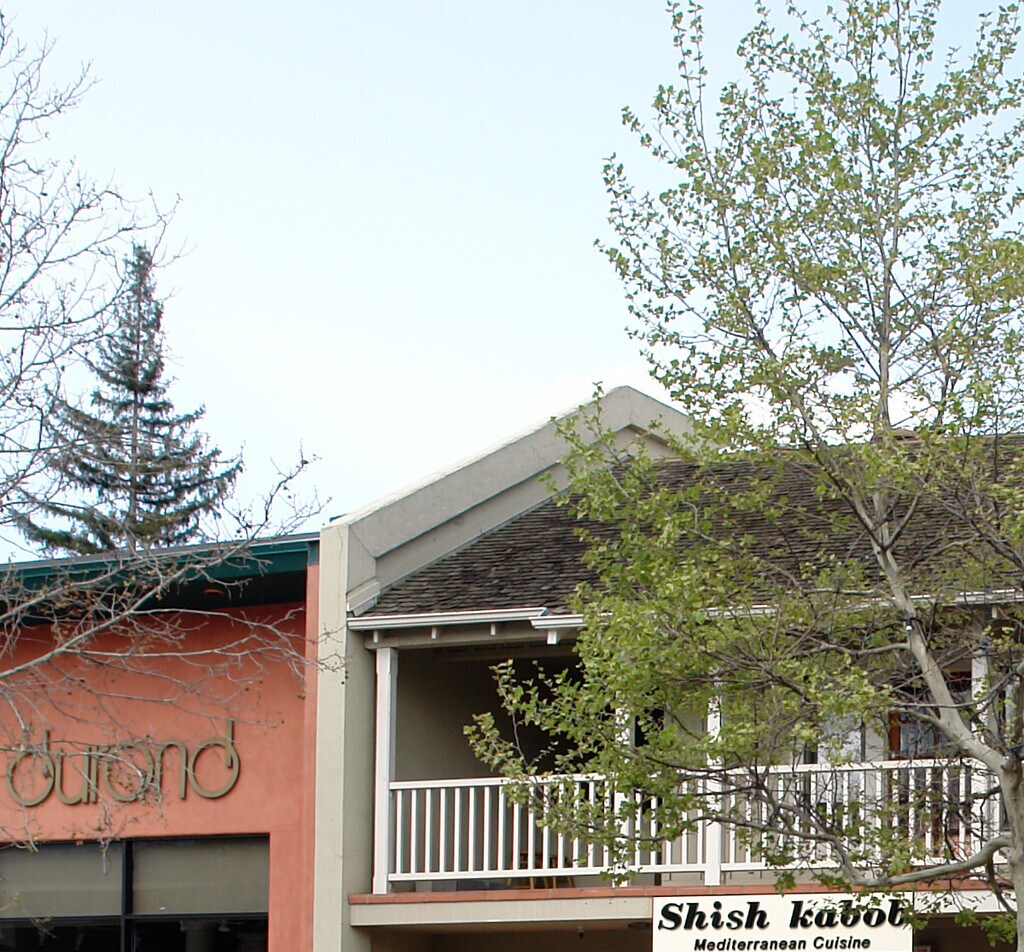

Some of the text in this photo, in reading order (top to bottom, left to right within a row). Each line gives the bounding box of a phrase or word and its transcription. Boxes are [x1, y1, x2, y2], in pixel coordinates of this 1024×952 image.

[6, 719, 240, 807] durand
[658, 901, 770, 930] Shish
[694, 936, 871, 951] Mediterranean Cuisine
